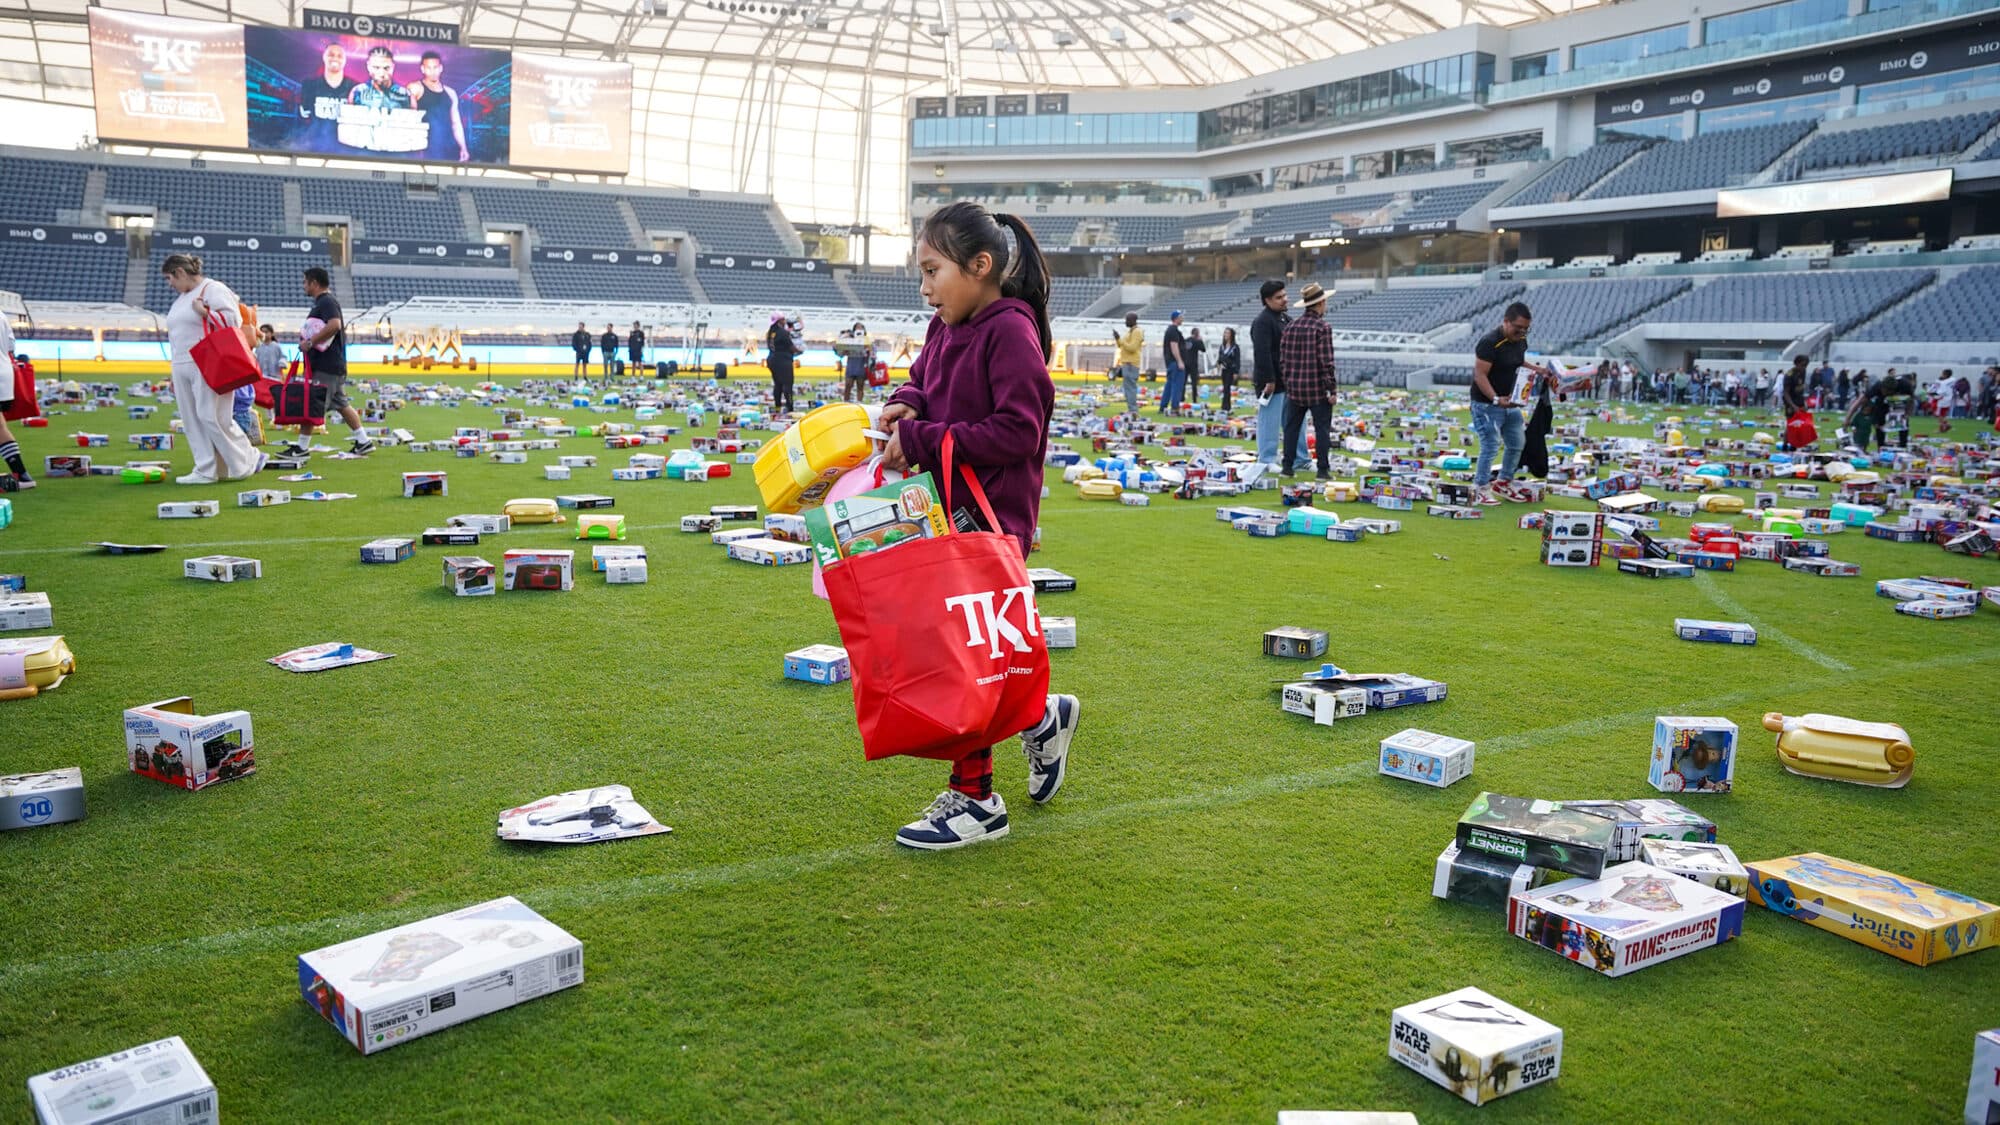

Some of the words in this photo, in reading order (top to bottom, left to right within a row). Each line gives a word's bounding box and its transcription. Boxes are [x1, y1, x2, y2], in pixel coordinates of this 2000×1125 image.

[311, 14, 350, 29] BMO
[376, 22, 453, 40] STADIUM
[1968, 41, 2000, 56] BMO
[1880, 58, 1907, 71] BMO
[1802, 72, 1826, 84] BMO
[1732, 85, 1755, 95] BMO
[1611, 103, 1631, 114] BMO
[22, 800, 52, 819] DC
[1471, 837, 1526, 857] HORNET
[1850, 912, 1916, 950] Stitch
[370, 1014, 409, 1031] WARNING:
[1394, 1028, 1430, 1054] WARS
[1395, 1021, 1430, 1046] STAR
[1521, 1055, 1555, 1072] WARS
[1520, 1066, 1551, 1084] STAR
